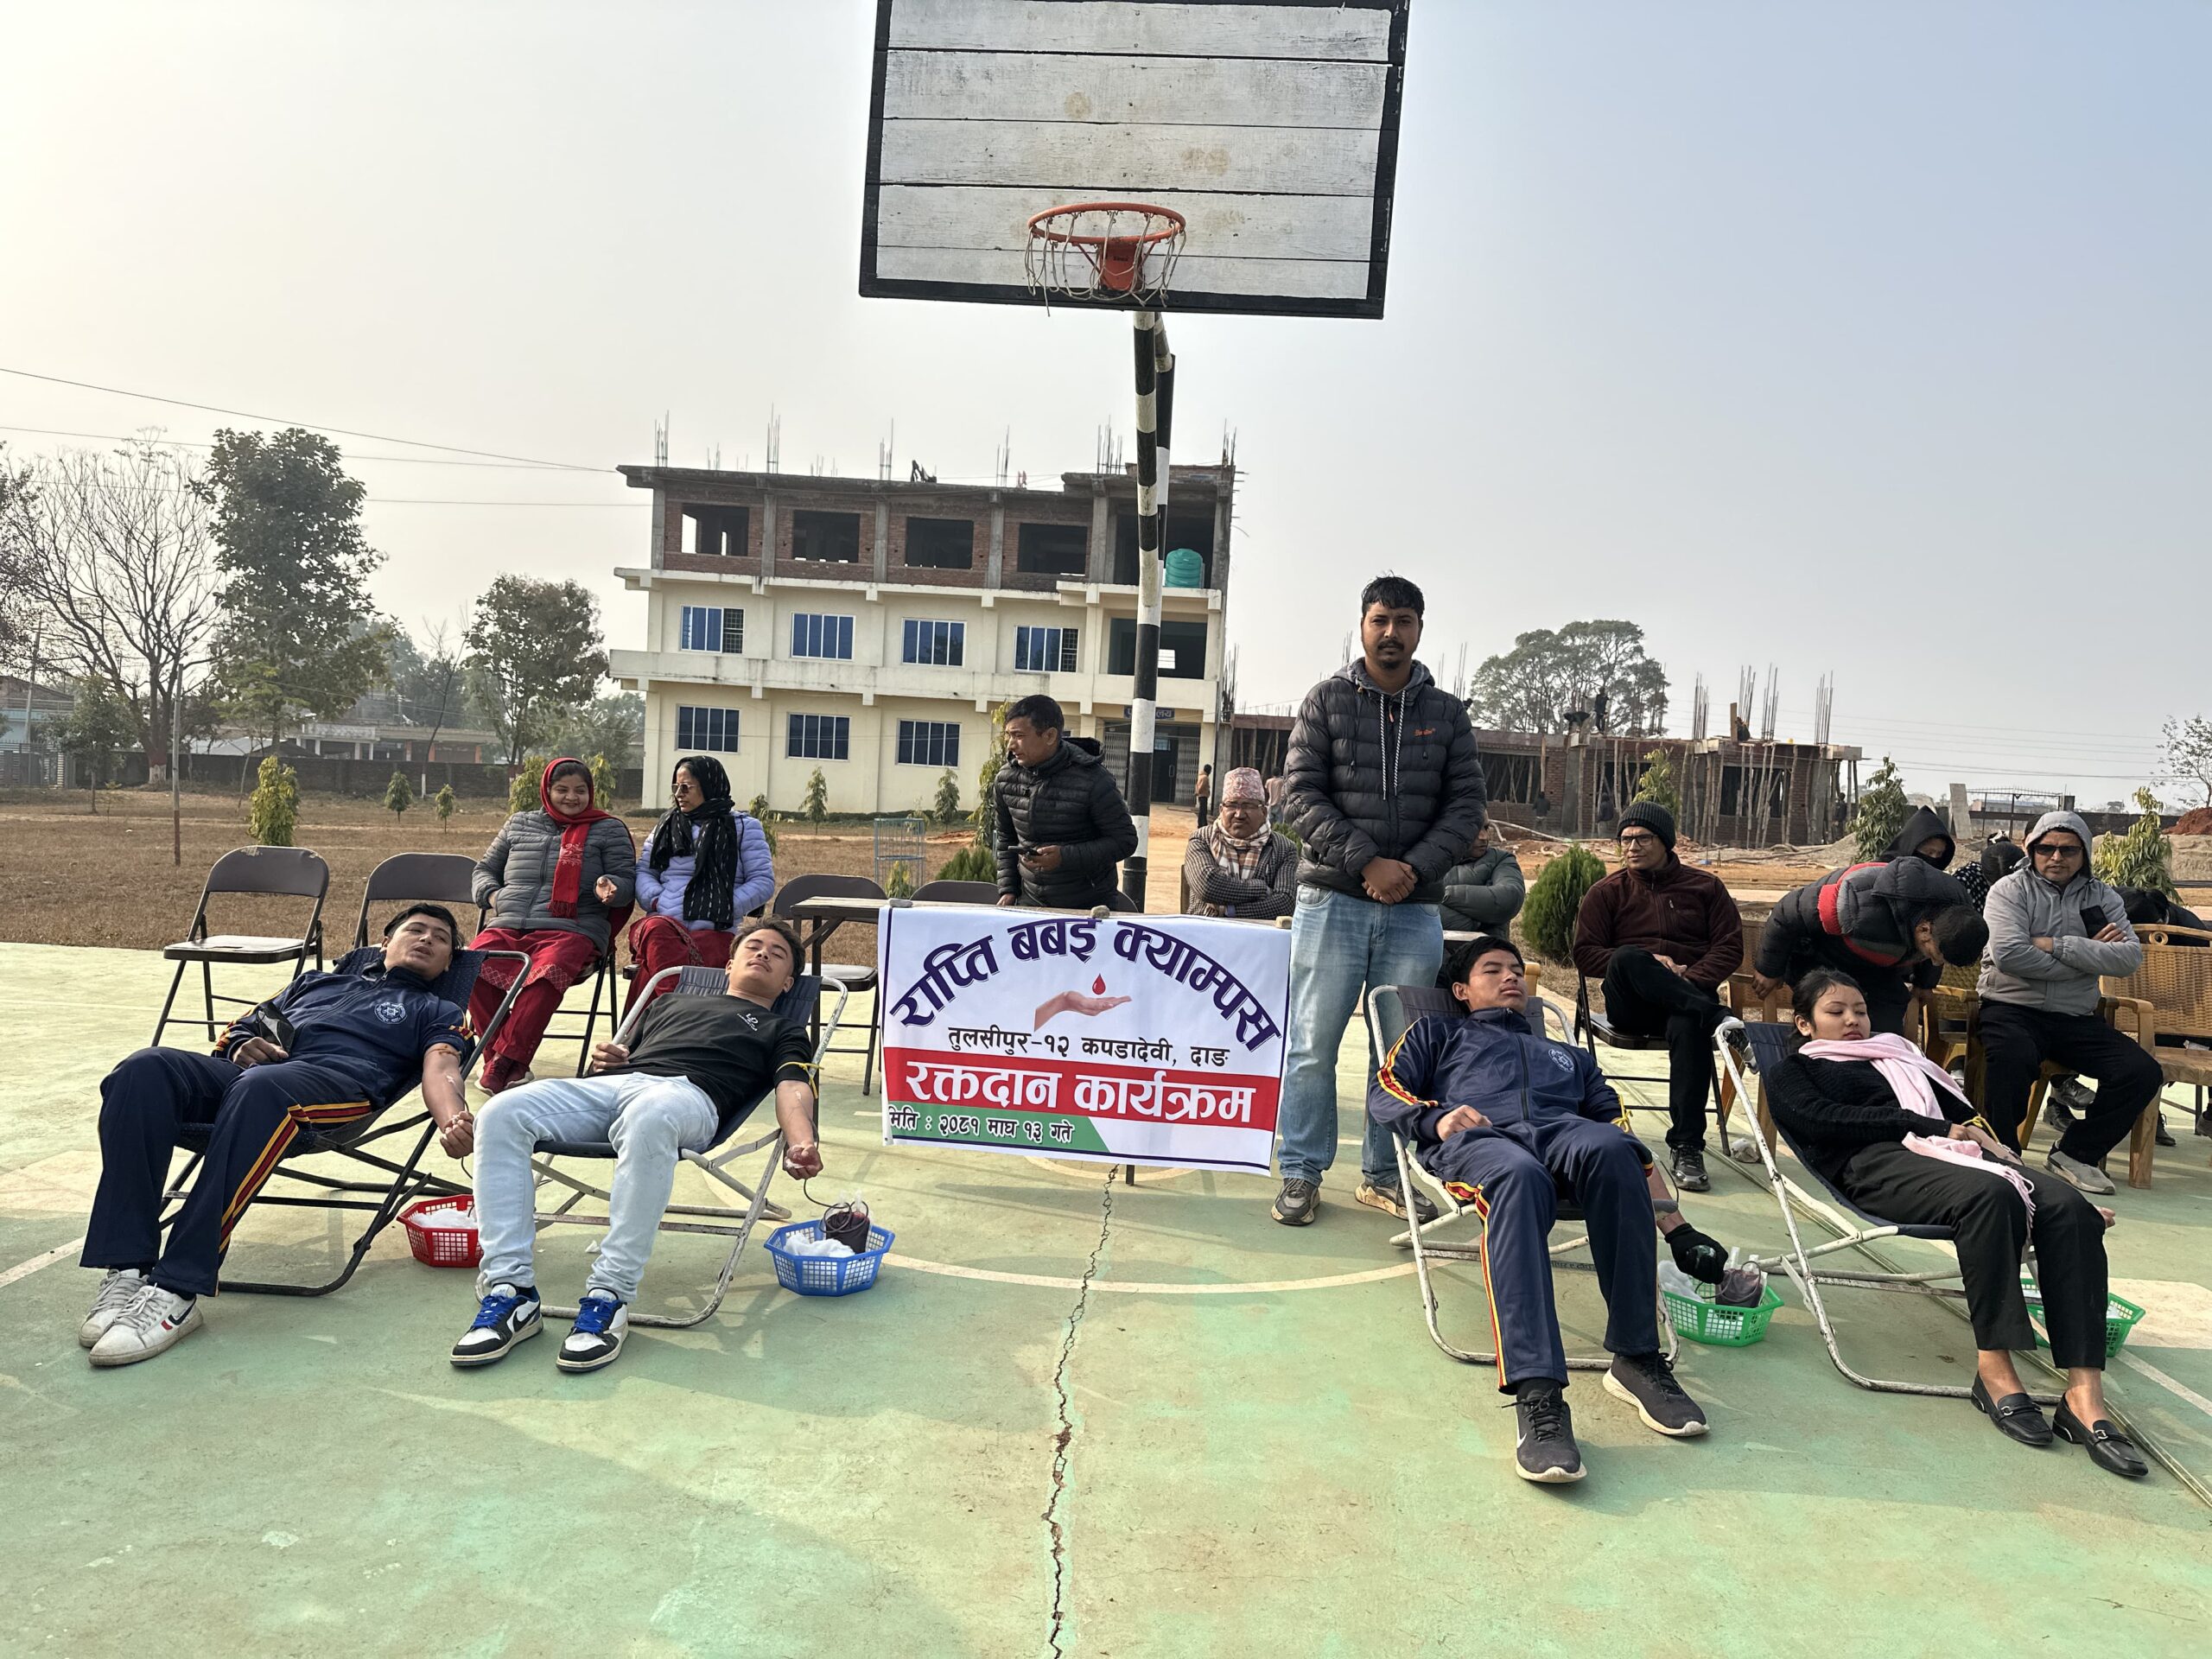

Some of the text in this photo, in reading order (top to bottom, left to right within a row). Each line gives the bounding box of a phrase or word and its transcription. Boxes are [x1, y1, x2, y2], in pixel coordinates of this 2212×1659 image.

[889, 933, 1000, 1028] राप्ति
[1113, 920, 1282, 1053] क्याम्पस
[948, 1027, 1070, 1057] तुलसीपुर-१२
[906, 1061, 1256, 1123] रक्तदान कार्यक्रम
[939, 1115, 980, 1136] २०८१
[987, 1117, 1018, 1137] माघ
[1023, 1121, 1044, 1143] १३
[1049, 1118, 1075, 1143] गते
